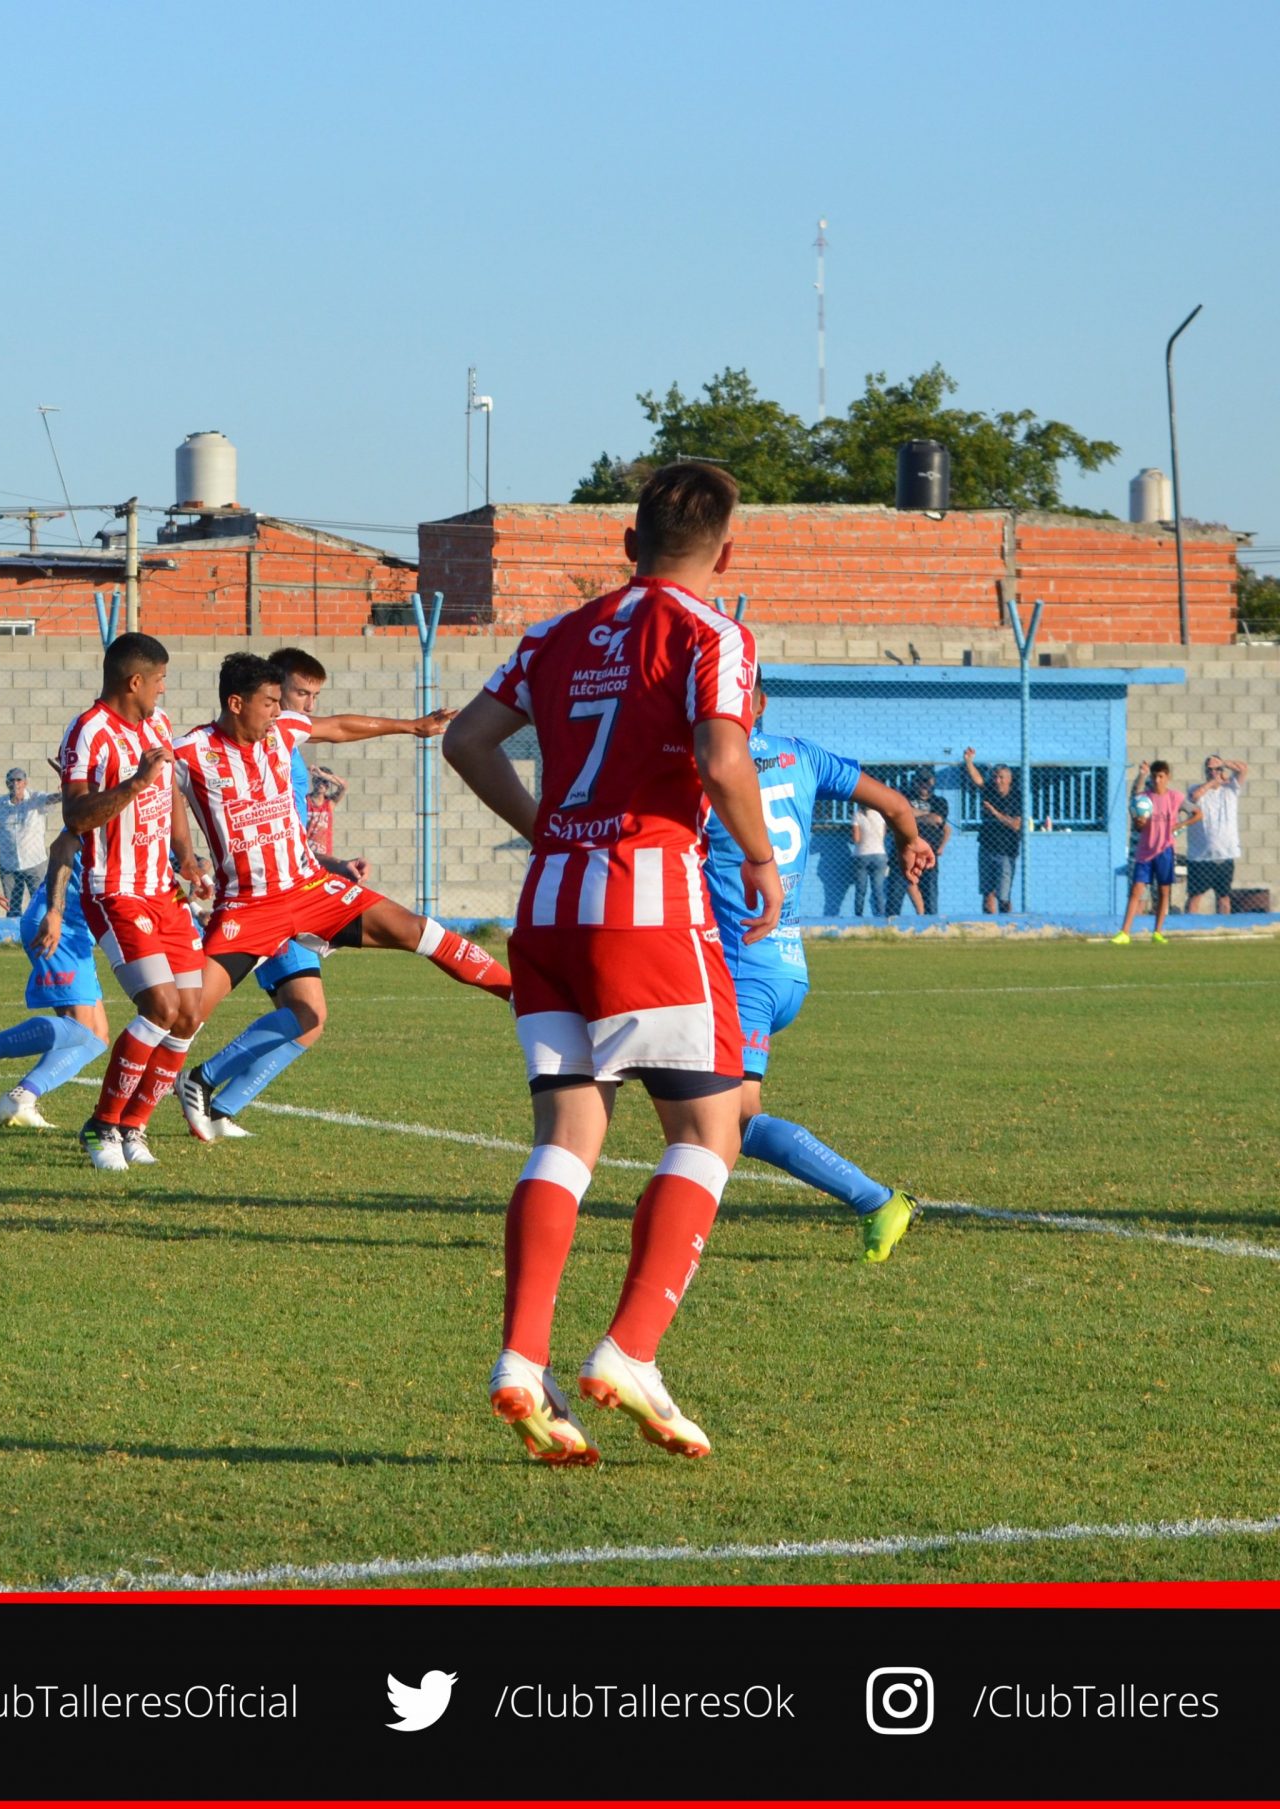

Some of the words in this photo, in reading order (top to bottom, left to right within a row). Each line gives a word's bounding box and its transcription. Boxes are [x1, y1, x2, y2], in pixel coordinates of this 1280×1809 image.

[559, 698, 618, 810] 7
[544, 812, 627, 842] Sávory
[792, 1129, 837, 1167] URQUIZA
